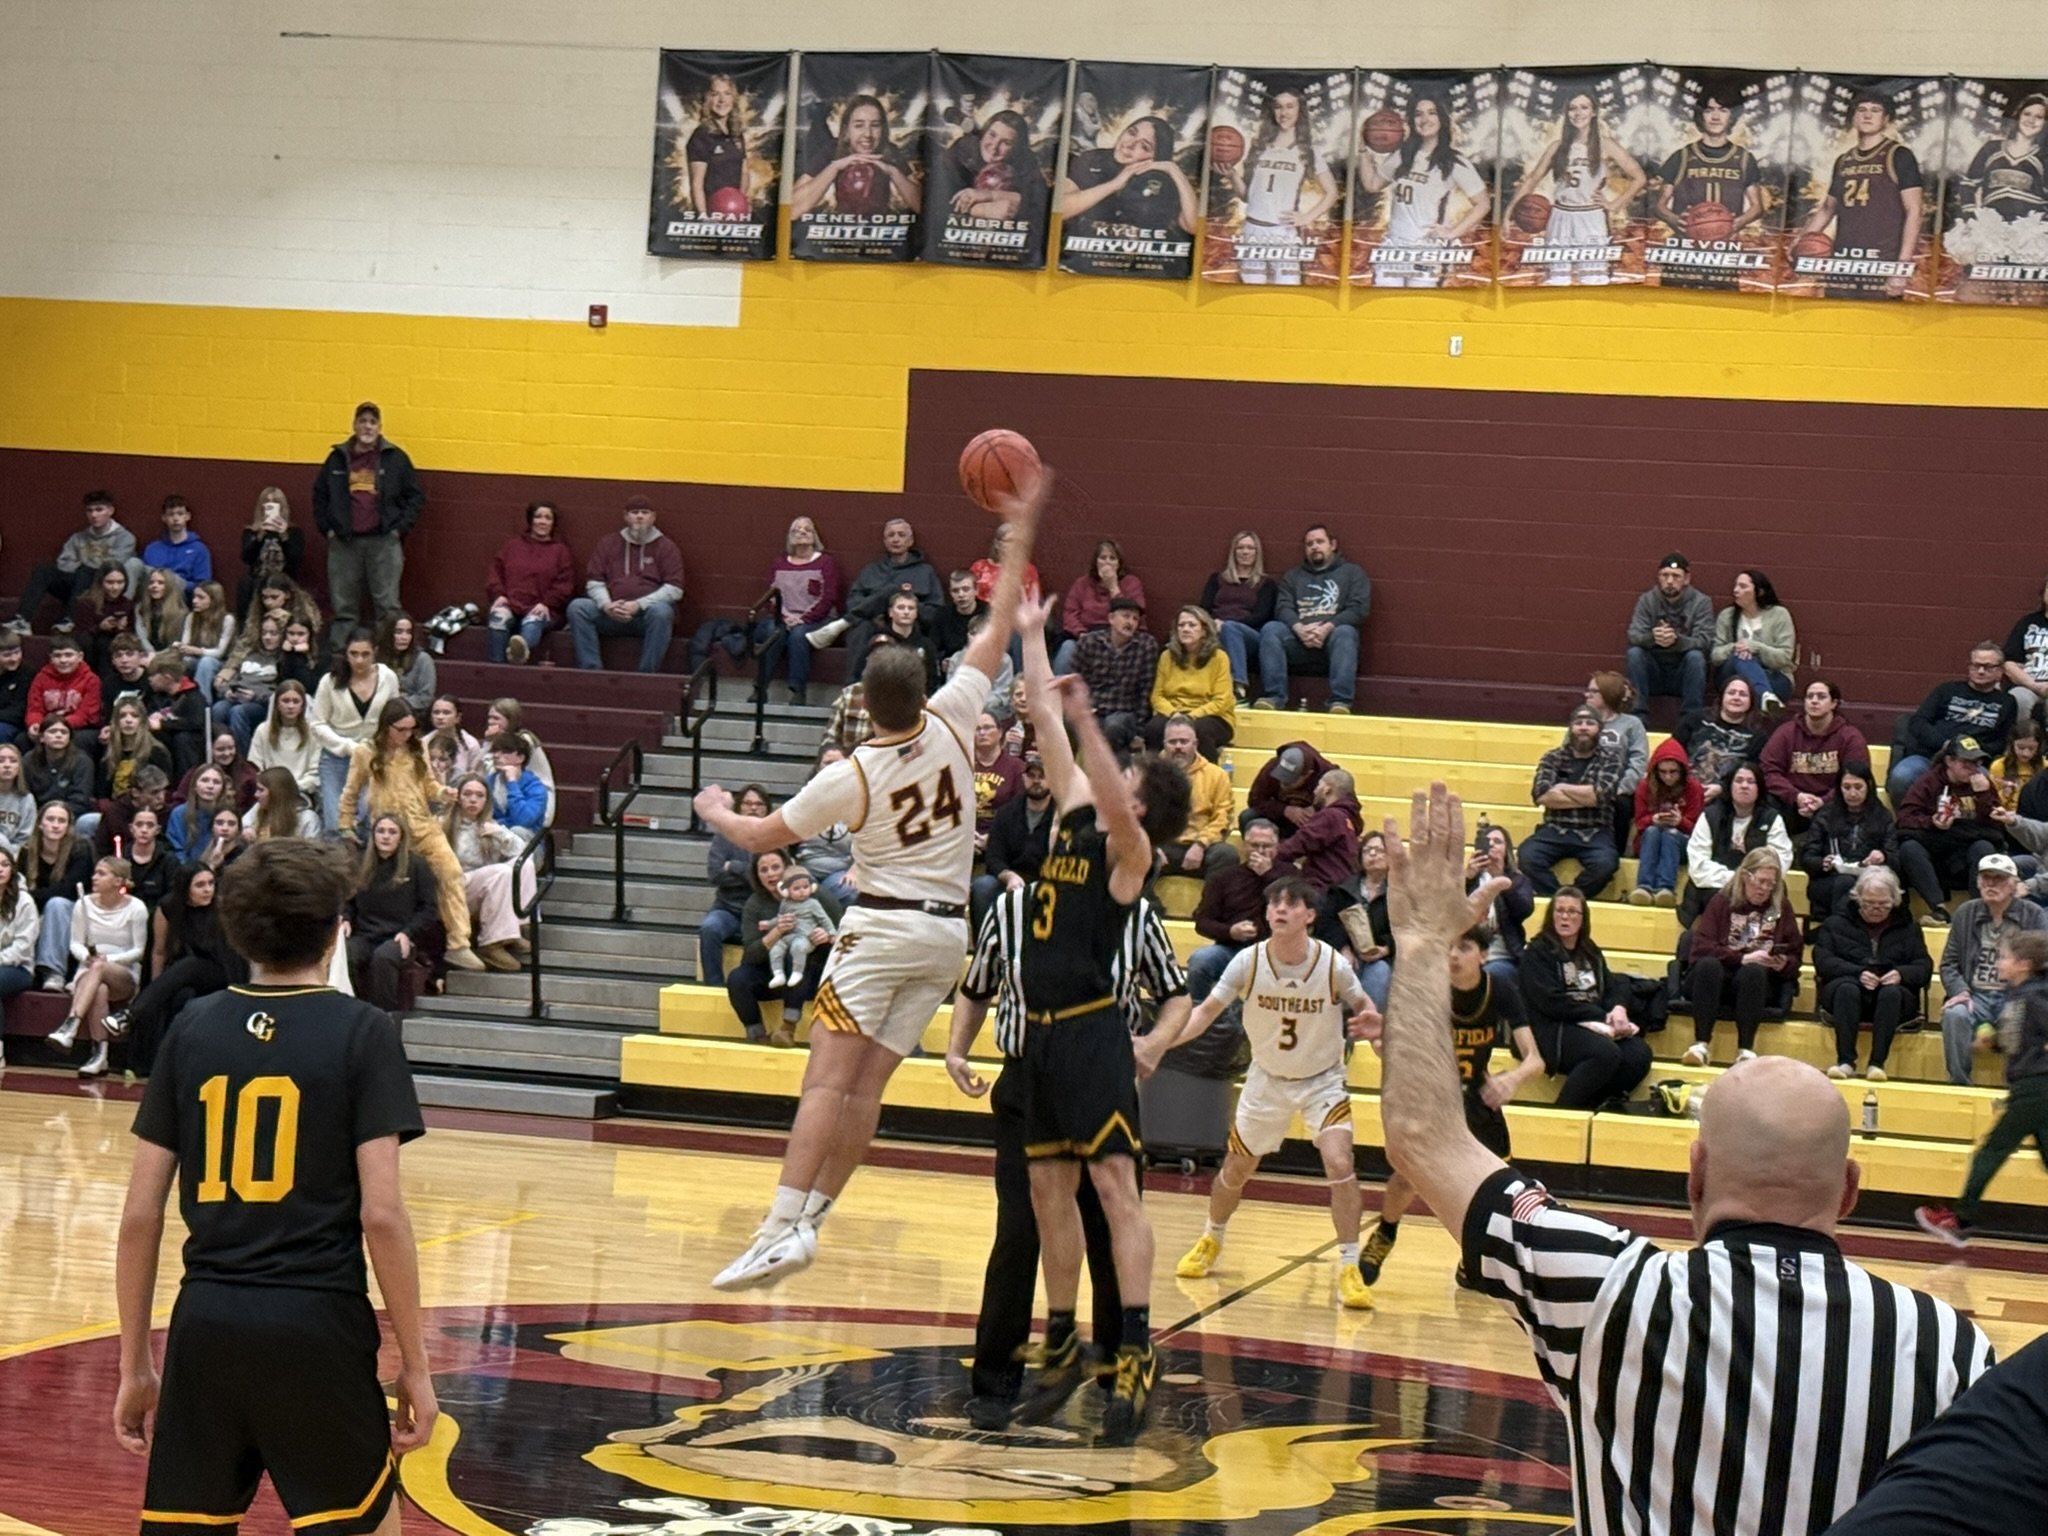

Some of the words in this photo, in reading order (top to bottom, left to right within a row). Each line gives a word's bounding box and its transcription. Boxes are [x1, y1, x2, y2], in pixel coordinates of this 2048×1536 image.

[1688, 167, 1741, 180] PIRATES
[1706, 182, 1720, 203] 11
[1843, 179, 1870, 207] 24
[683, 211, 752, 222] SARAH
[946, 216, 1029, 230] AUBREE
[666, 221, 764, 239] CRAVER
[806, 225, 909, 240] SUTLIFF
[942, 228, 1027, 247] VARGA
[1096, 226, 1167, 239] KYLEE
[1064, 236, 1192, 257] MAYVILLE
[1231, 245, 1317, 261] THOLS
[1666, 237, 1742, 251] DEVON
[1834, 247, 1881, 258] JOE
[1368, 247, 1475, 264] HUTSON
[1520, 246, 1624, 264] MORRIS
[1795, 256, 1917, 277] SHARISH
[890, 765, 962, 847] 24
[1033, 882, 1057, 940] 3
[1257, 994, 1325, 1014] SOUTHEAST
[1279, 1016, 1298, 1051] 3
[197, 1075, 301, 1204] 10
